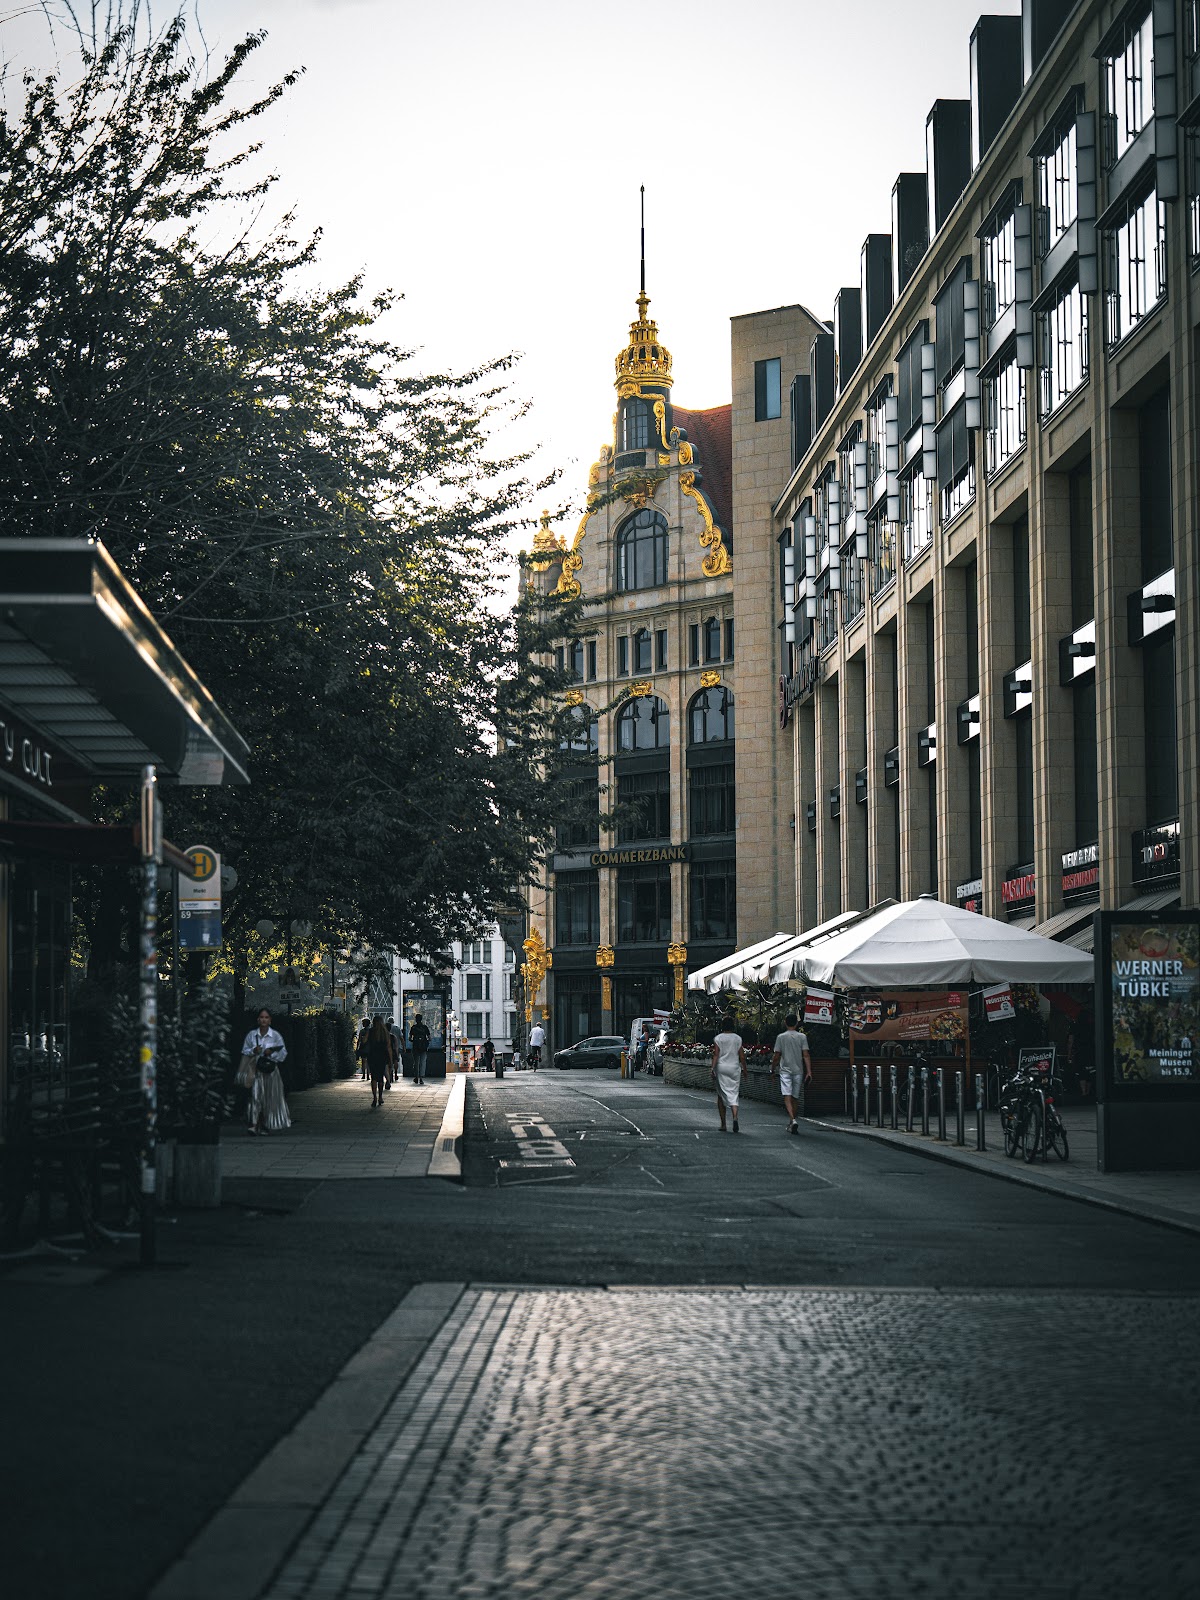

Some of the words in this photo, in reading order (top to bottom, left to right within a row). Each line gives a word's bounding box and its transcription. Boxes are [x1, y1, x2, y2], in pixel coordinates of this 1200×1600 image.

[591, 847, 686, 865] COMMERZBANK
[1061, 867, 1098, 890] RESTAURANT
[1115, 960, 1183, 976] WERNER
[1119, 978, 1170, 997] TÜBKE
[806, 999, 833, 1008] FRÜHSTÜCK
[986, 995, 1012, 1005] FRÜHSTÜCK
[900, 1015, 930, 1027] Pizza
[1021, 1051, 1053, 1063] Frühstück
[1149, 1048, 1192, 1059] Meininger
[1160, 1058, 1192, 1067] Museen
[1161, 1068, 1171, 1076] bis
[1173, 1067, 1192, 1076] 15.9.
